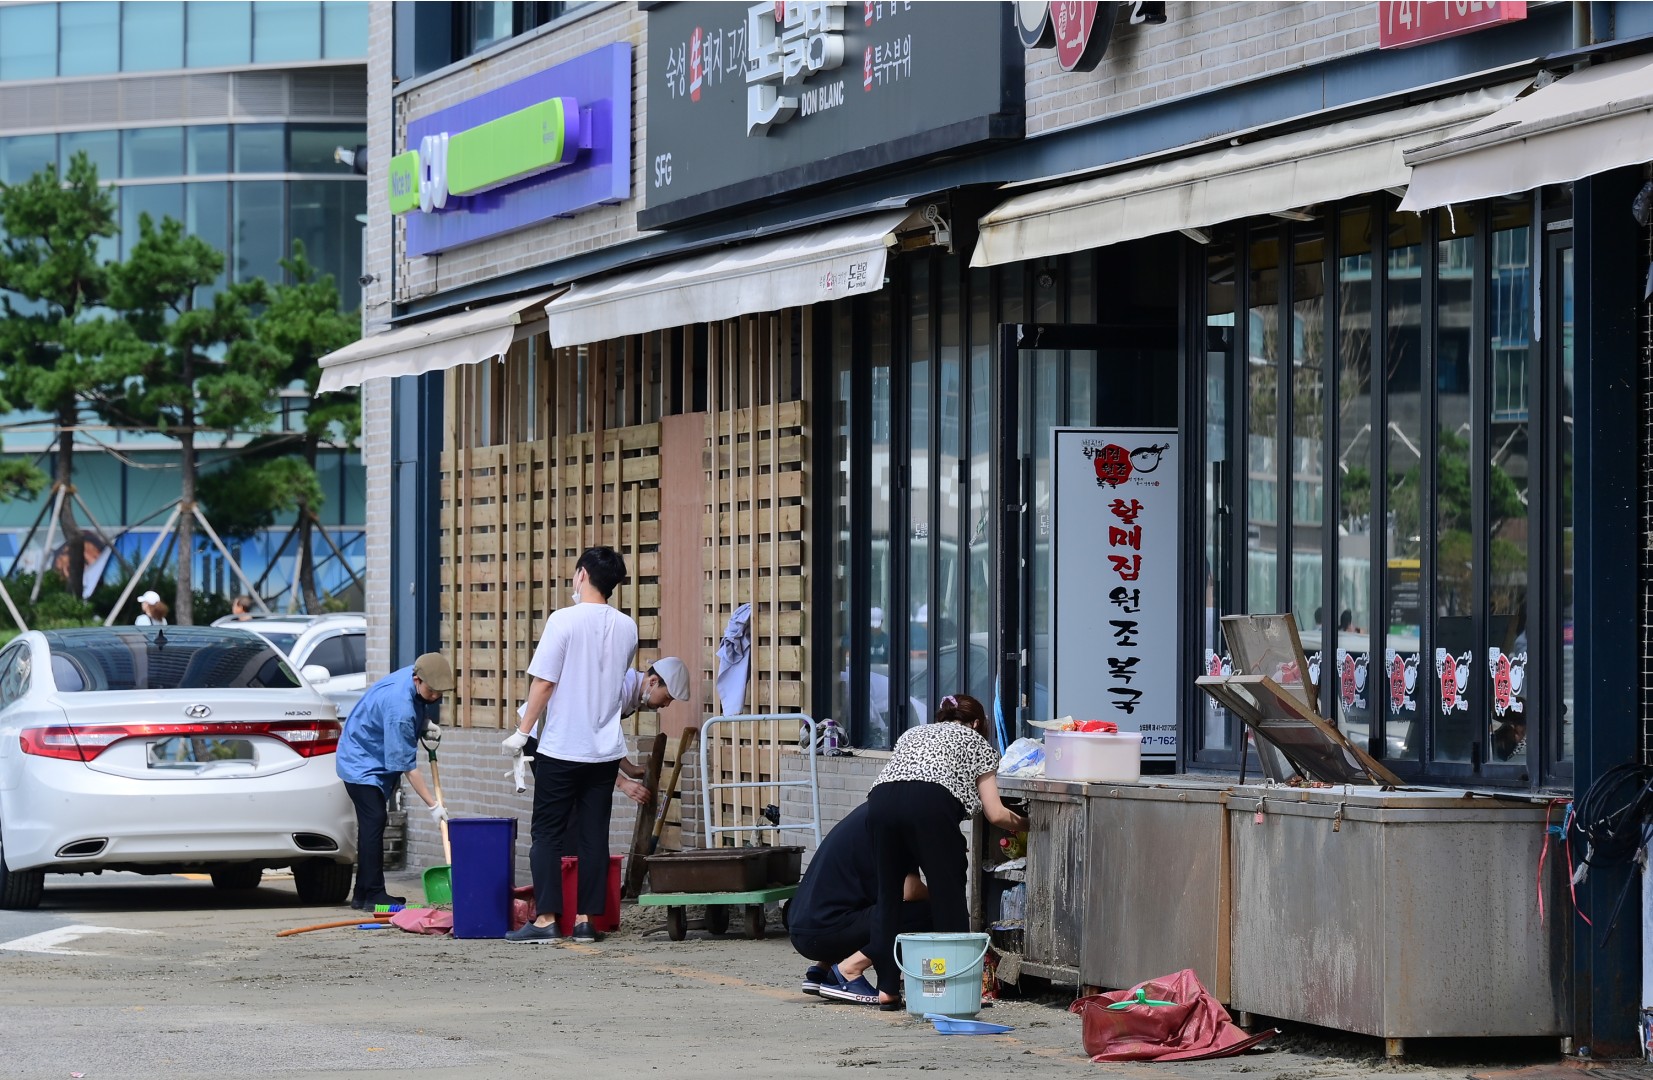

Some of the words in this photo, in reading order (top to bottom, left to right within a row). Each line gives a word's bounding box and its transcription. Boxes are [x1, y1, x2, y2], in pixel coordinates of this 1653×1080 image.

[666, 42, 686, 99] 숙성
[726, 19, 760, 77] 고깃
[801, 88, 818, 117] DON
[819, 80, 844, 111] BLANC
[655, 152, 672, 188] SFG
[1102, 463, 1127, 476] 원조
[1096, 477, 1120, 490] 복국
[855, 995, 880, 1003] croc
